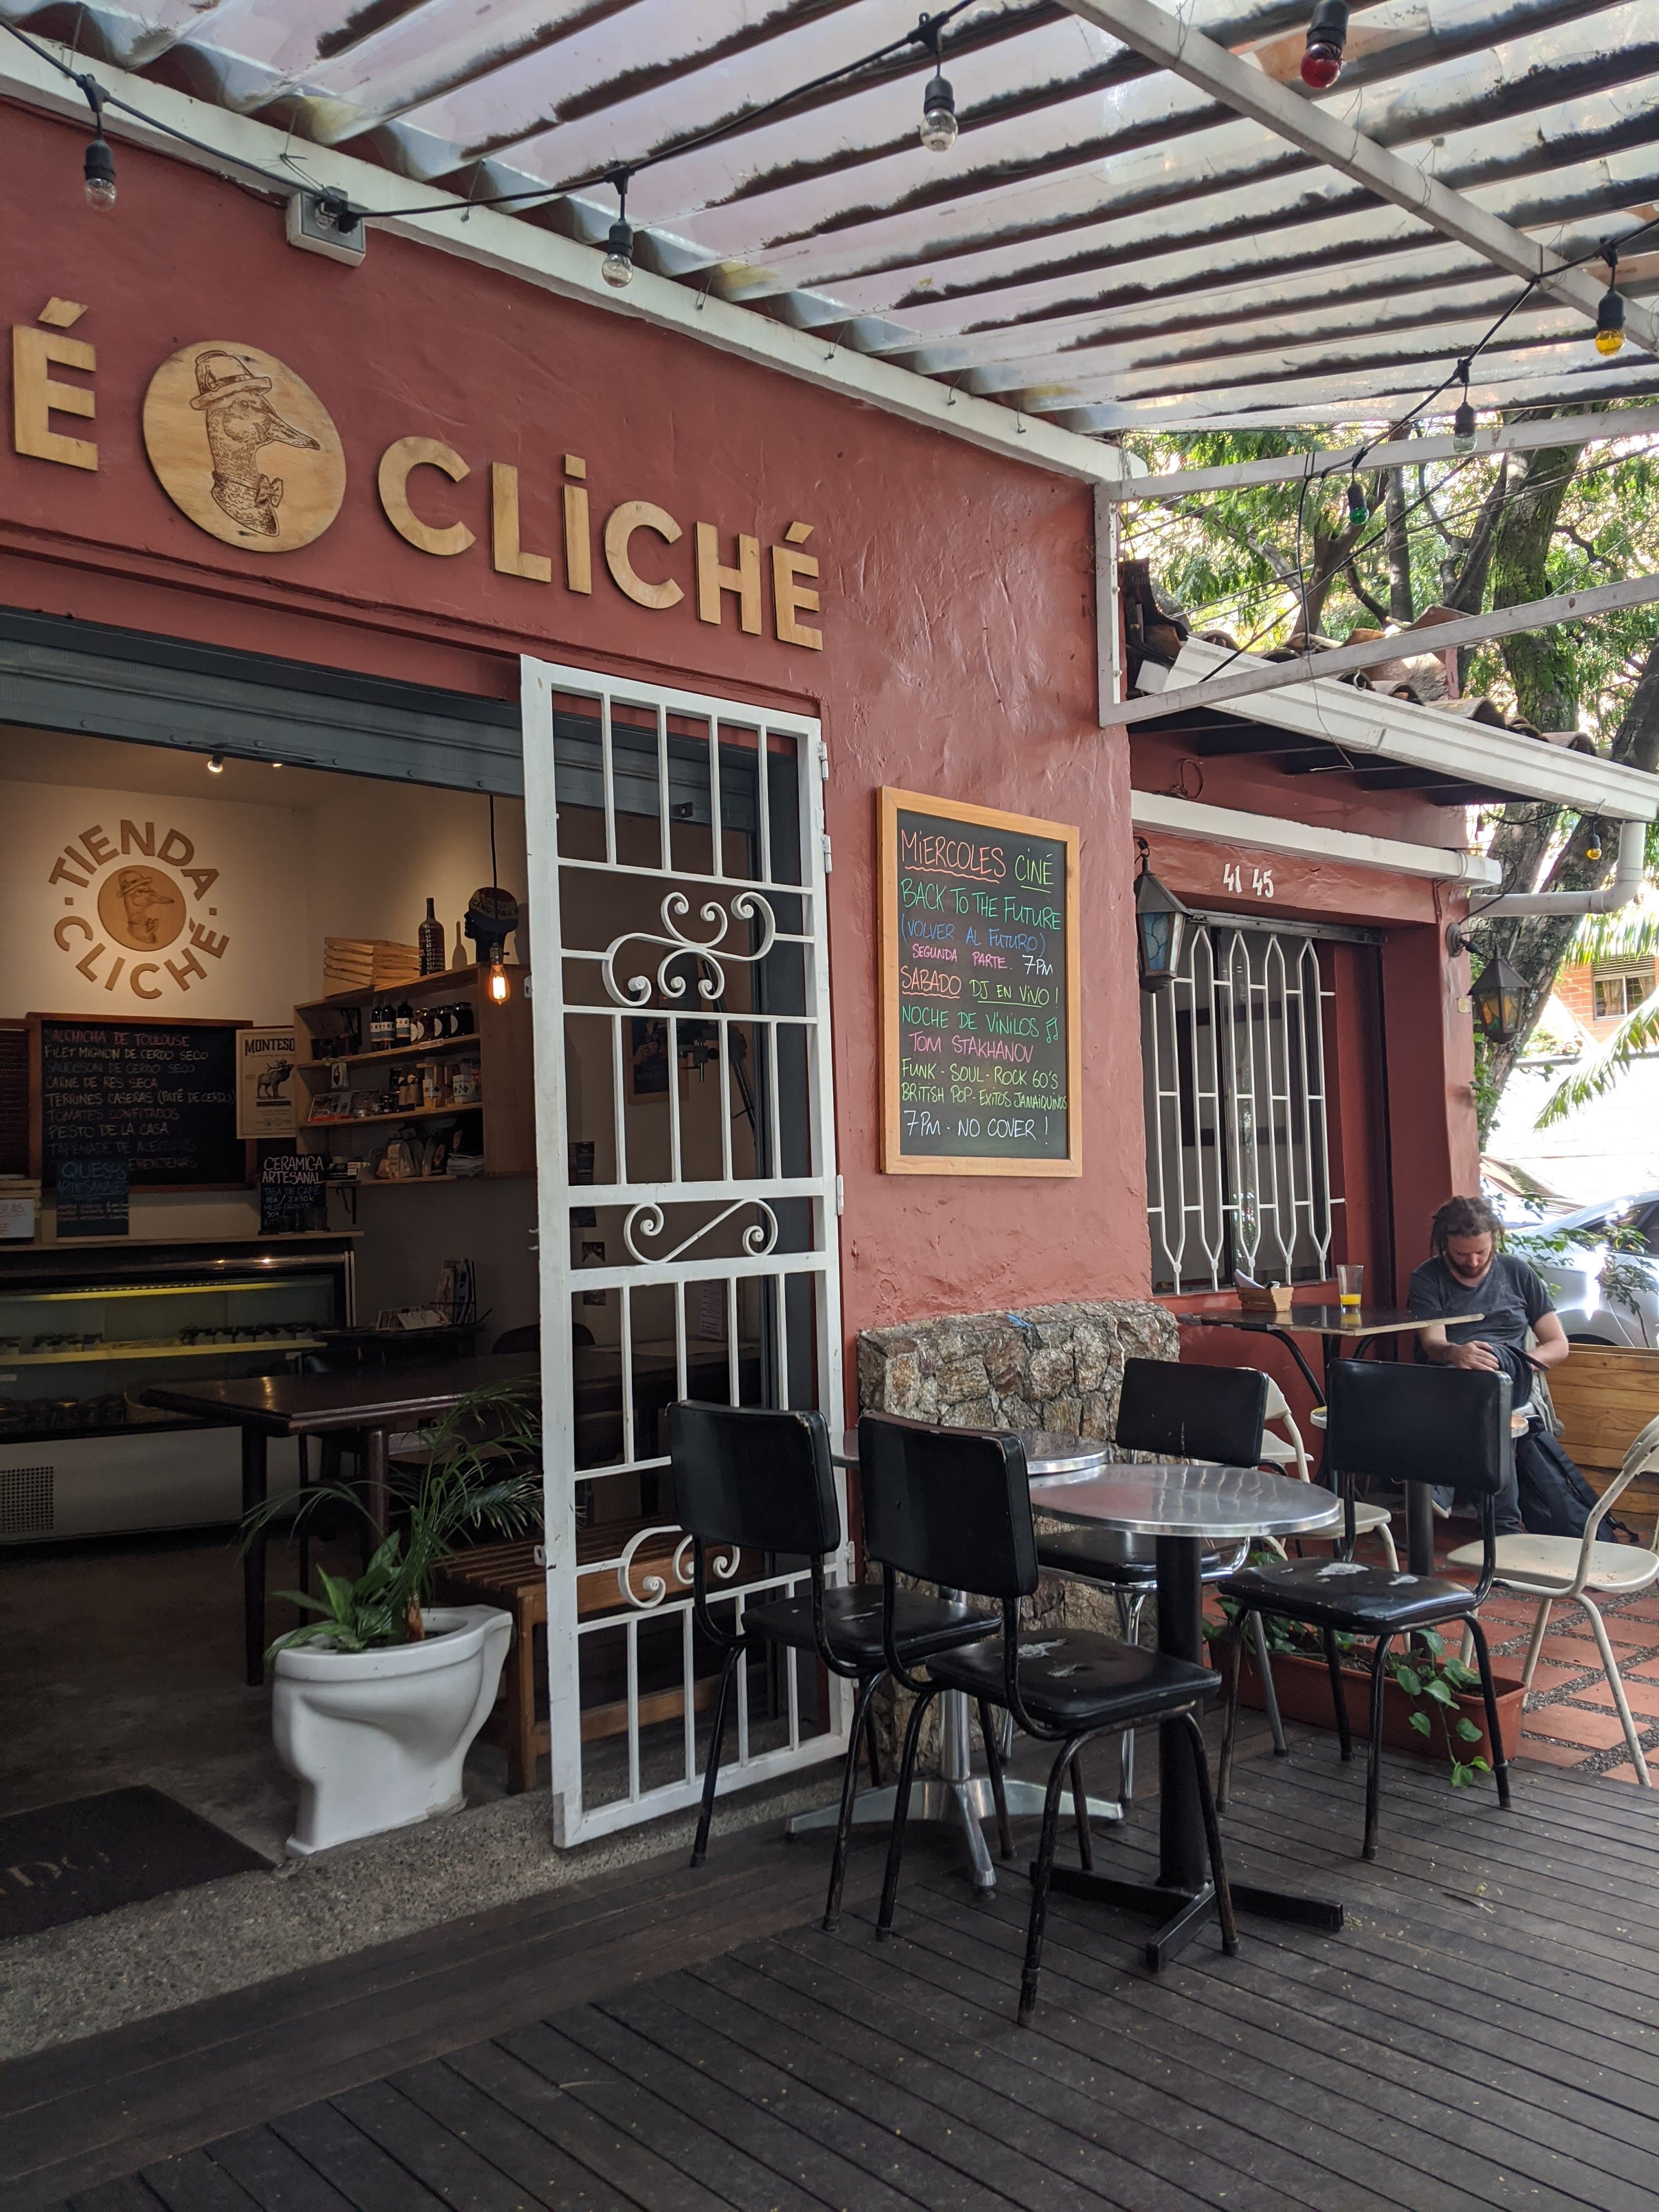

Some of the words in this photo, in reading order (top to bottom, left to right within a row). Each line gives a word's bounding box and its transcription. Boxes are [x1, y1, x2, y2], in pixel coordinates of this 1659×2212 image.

[13, 296, 99, 472] É
[49, 819, 219, 901] TIENDA
[1223, 863, 1242, 893] 41
[1252, 868, 1274, 898] 45
[901, 878, 945, 912] BACK
[971, 892, 998, 917] THE
[1004, 896, 1061, 930] FUTURE
[901, 913, 955, 943] (VOLVER
[966, 926, 981, 946] AL
[989, 928, 1045, 957] FUTURO)
[54, 916, 230, 999] CLICHÉ
[912, 943, 957, 962] SEGUNDA
[1022, 955, 1053, 975] 7PM
[900, 966, 962, 996] SABADO
[969, 979, 989, 1000] DJ
[997, 985, 1011, 1000] EN
[901, 1005, 949, 1029] NOCHE
[958, 1012, 978, 1030] DE
[44, 1045, 74, 1058] FILET
[125, 1049, 137, 1059] DE
[140, 1050, 174, 1060] CERDO
[180, 1051, 208, 1060] SECO
[114, 1031, 130, 1046] DE
[135, 1032, 190, 1047] TOULOUSE
[909, 1031, 941, 1052] TOM
[952, 1036, 1034, 1063] STAKHANOV
[46, 1075, 80, 1089] CARNE
[84, 1076, 97, 1088] DE
[104, 1076, 124, 1089] RES
[129, 1077, 159, 1089] SECA
[902, 1058, 936, 1079] FUNK
[950, 1063, 983, 1082] SOUL
[994, 1067, 1027, 1086] ROCK
[108, 1091, 153, 1104] CASERAS
[188, 1092, 199, 1103] DE
[48, 1124, 94, 1140] PESTO
[100, 1124, 117, 1136] DE
[121, 1122, 136, 1136] LA
[140, 1122, 170, 1136] CASA
[904, 1110, 940, 1137] 7PM
[958, 1120, 980, 1137] NO
[262, 1171, 324, 1184] ARTESANAL
